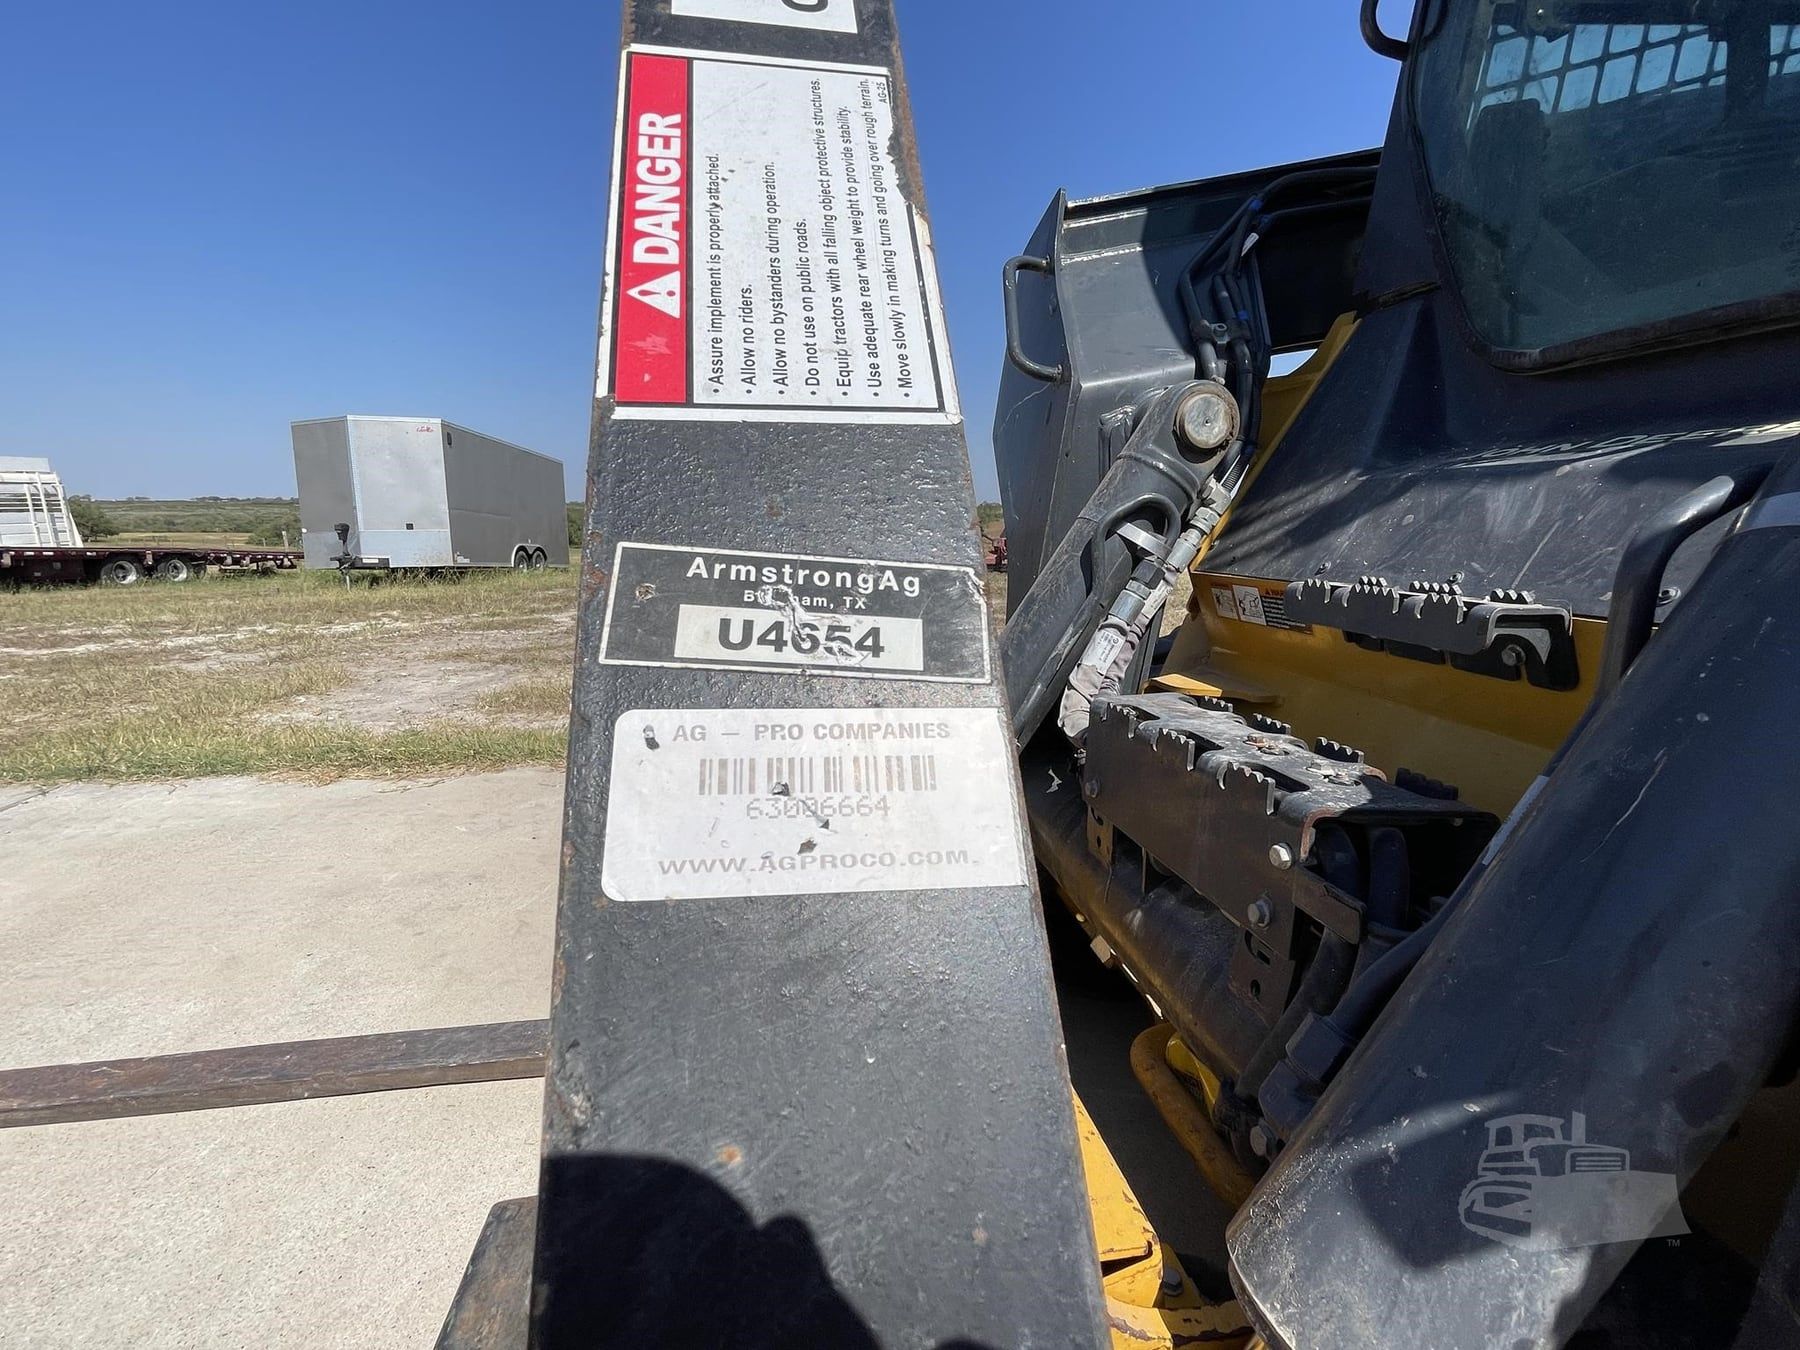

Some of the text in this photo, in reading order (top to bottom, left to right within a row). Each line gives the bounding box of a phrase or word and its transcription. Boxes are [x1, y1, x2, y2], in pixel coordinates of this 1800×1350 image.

[876, 81, 889, 104] AG-25
[633, 112, 682, 265] DANGER
[810, 78, 853, 387] Equip tractors with all falling object protective structures.
[837, 105, 881, 388] Use adequate rear wheel weight to provide stability.
[858, 78, 912, 389] Move slowly in making turns and going over rough terrain.
[706, 152, 724, 386] Assure implement is properly attached.
[739, 283, 756, 386] Allow no riders.
[762, 161, 788, 388] Allow no bystanders during operation.
[793, 218, 820, 387] Do not use on public roads.
[686, 556, 921, 598] ArmstrongAg
[718, 617, 885, 659] U4654
[842, 596, 867, 610] TX
[672, 725, 708, 742] AG
[754, 724, 804, 741] PRO
[813, 722, 951, 741] COMPANIES
